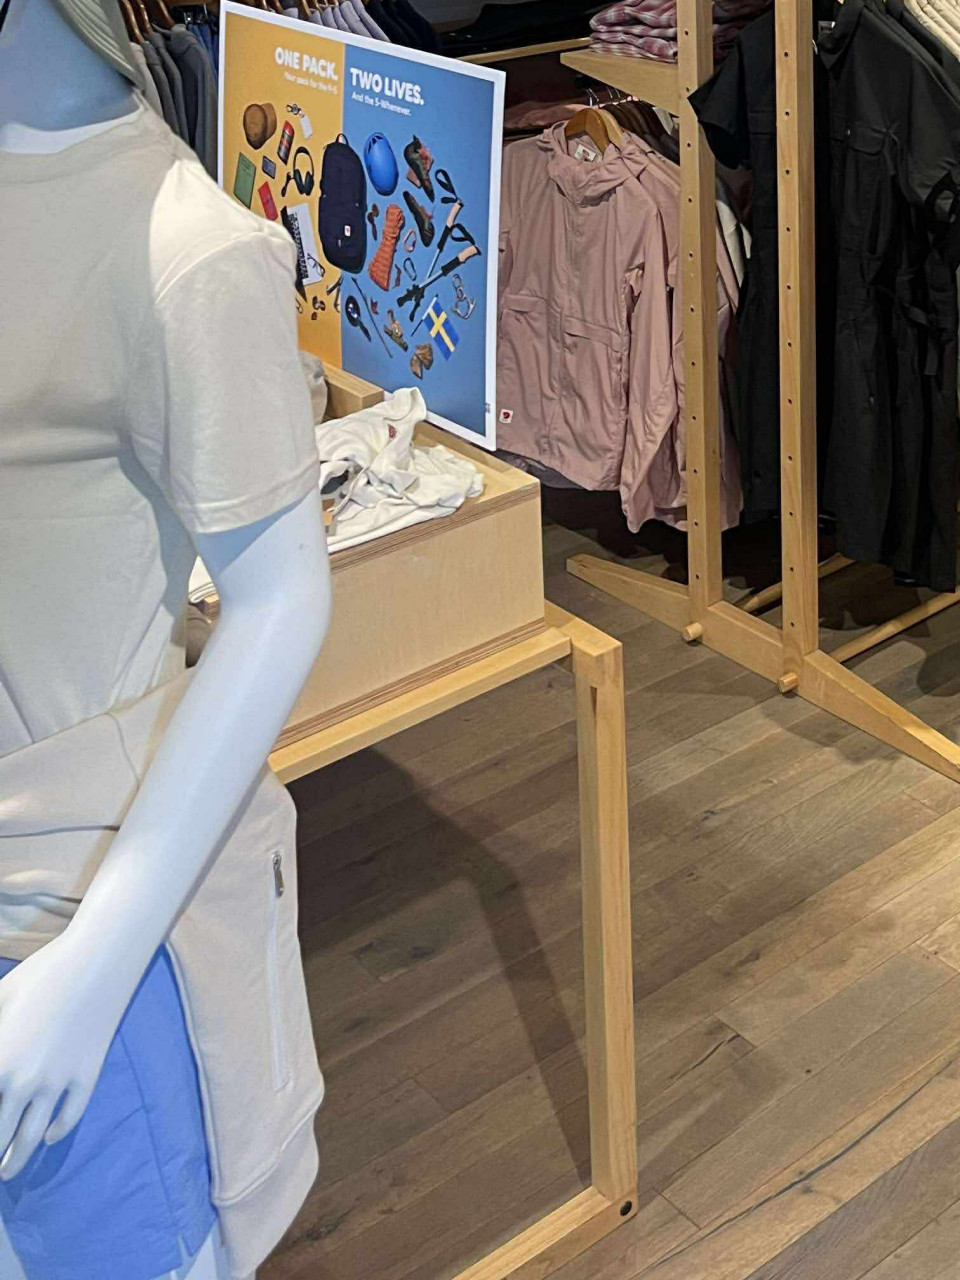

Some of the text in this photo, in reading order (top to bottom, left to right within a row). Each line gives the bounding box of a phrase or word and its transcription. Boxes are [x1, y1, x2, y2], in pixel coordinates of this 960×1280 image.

[274, 46, 339, 81] ONE PACK.
[350, 67, 425, 106] TWO LIVES.
[351, 91, 364, 103] And
[365, 94, 374, 106] the
